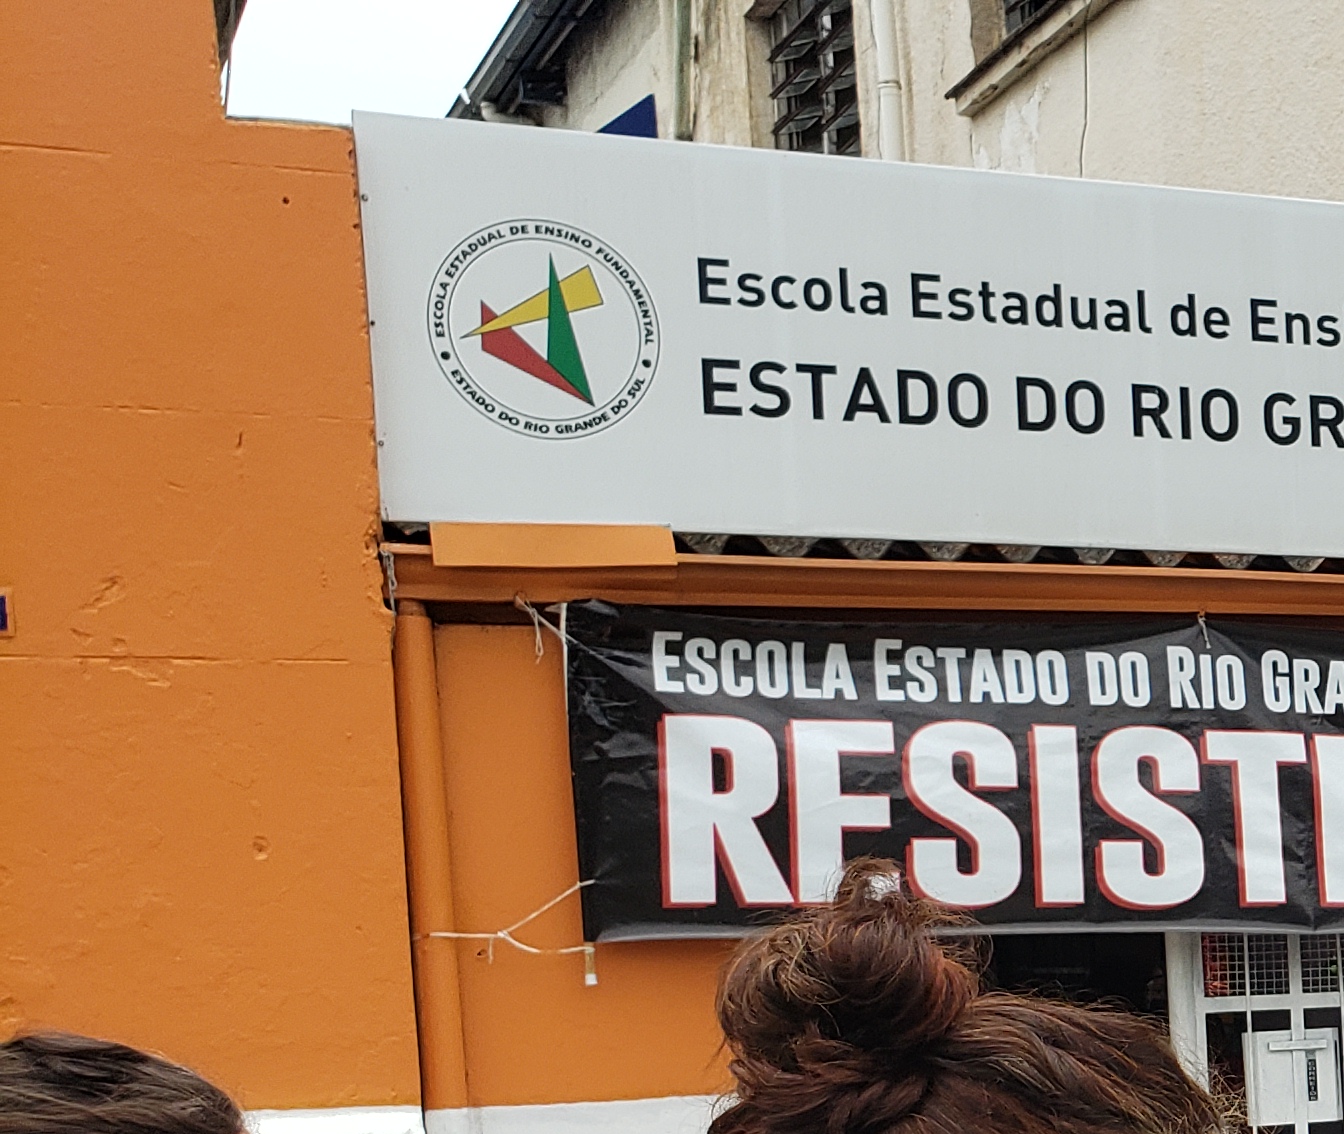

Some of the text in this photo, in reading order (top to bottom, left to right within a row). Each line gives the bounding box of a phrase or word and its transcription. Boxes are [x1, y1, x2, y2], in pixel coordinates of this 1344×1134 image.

[434, 224, 654, 345] ESCOLA ESTADUAL DE ENSINO FUNDAMENTAL
[697, 257, 889, 317] Escola
[911, 272, 1152, 335] Estadual
[1169, 293, 1231, 340] de
[450, 368, 645, 434] ESTADO DO RIO GRANDE DO SUL
[701, 357, 989, 428] ESTADO
[1016, 376, 1106, 435] DO
[1131, 383, 1240, 442] RIO
[651, 631, 858, 700] ESCOLA
[874, 638, 1070, 707] ESTADO
[1085, 651, 1151, 707] DO
[1167, 645, 1246, 711] RIO
